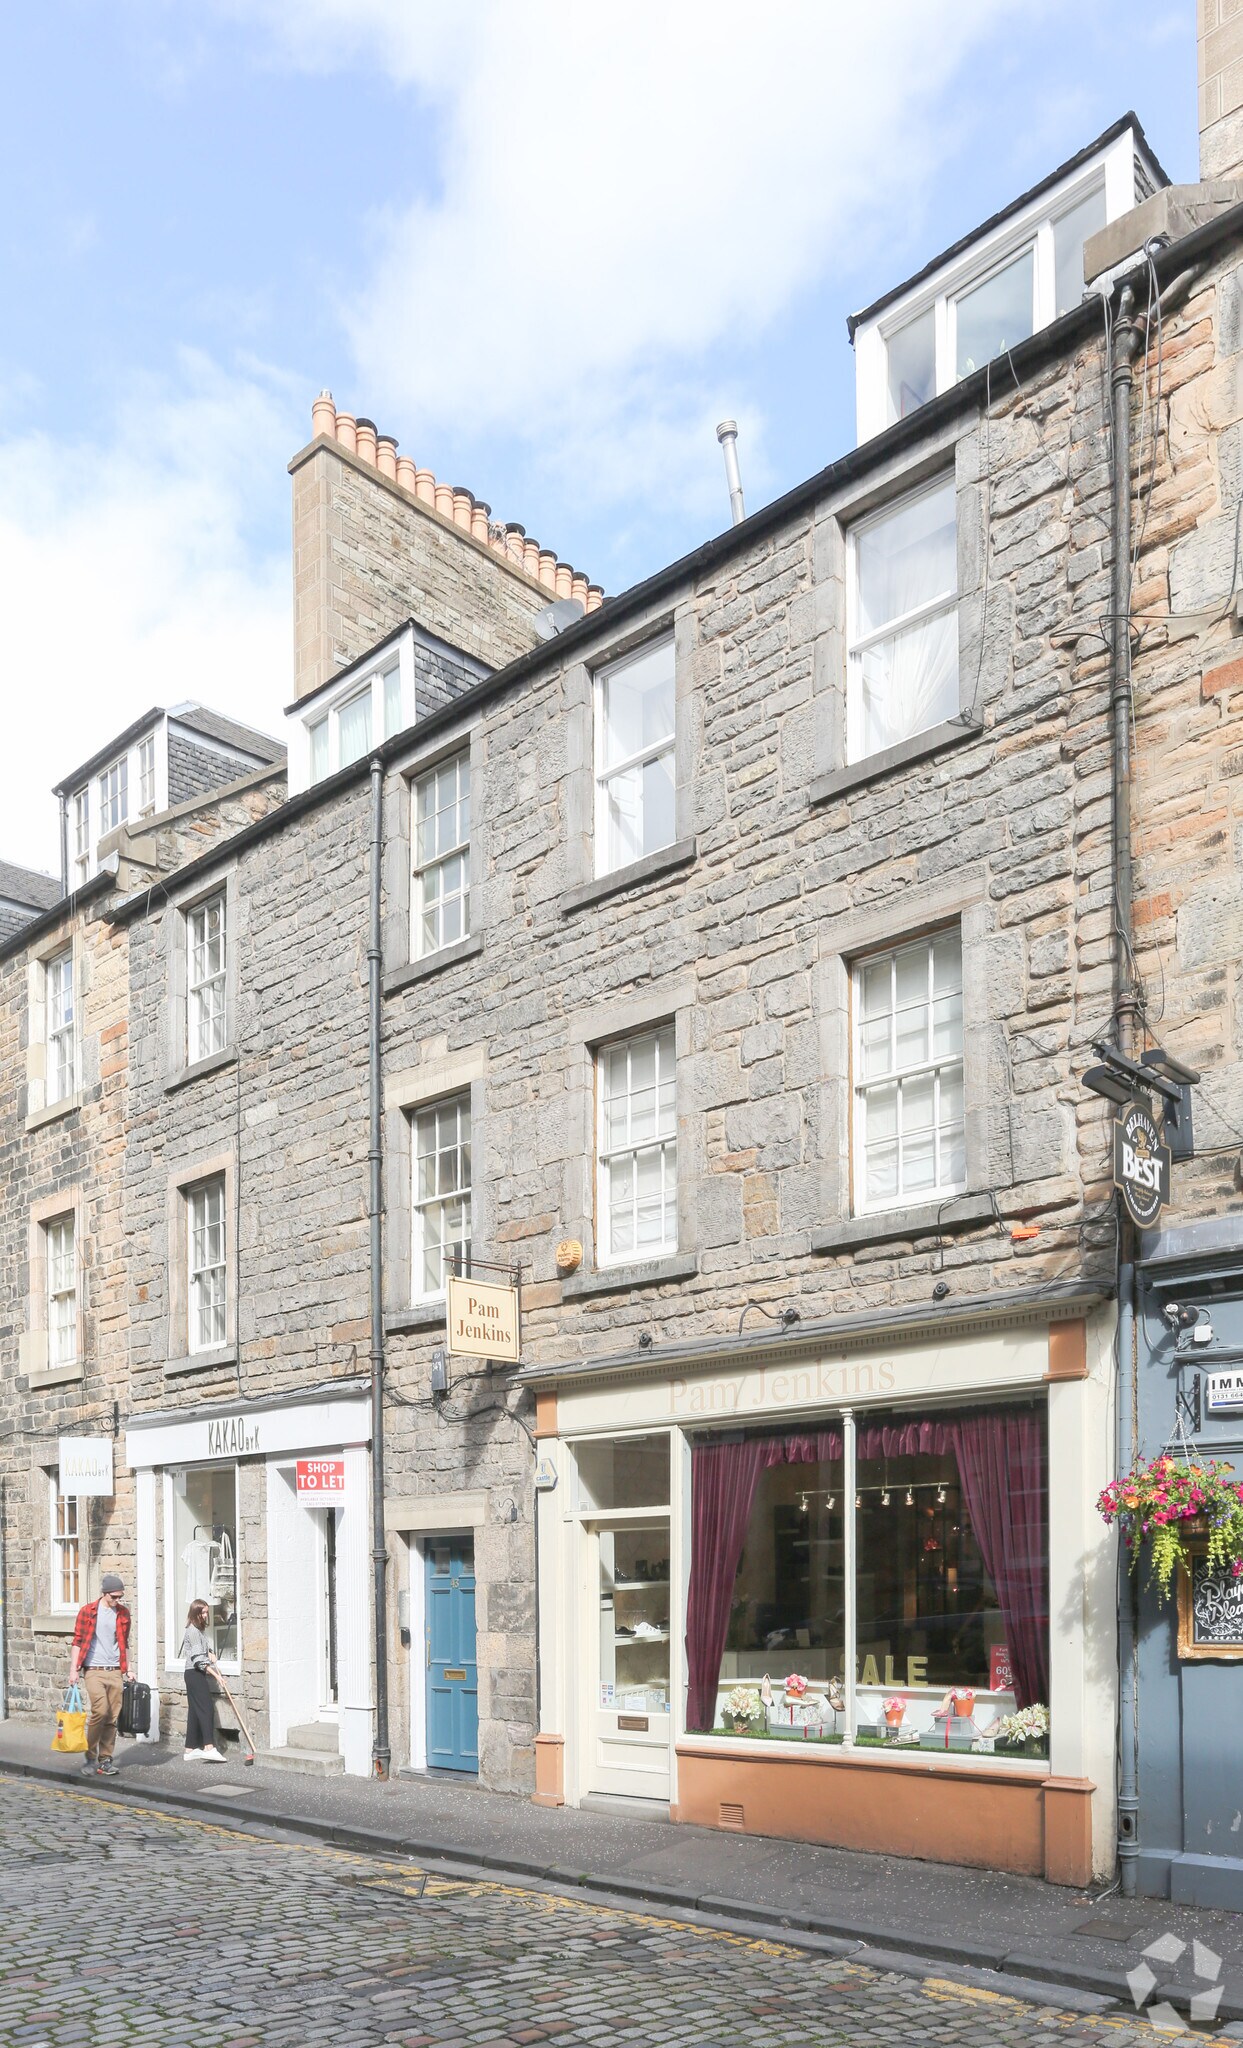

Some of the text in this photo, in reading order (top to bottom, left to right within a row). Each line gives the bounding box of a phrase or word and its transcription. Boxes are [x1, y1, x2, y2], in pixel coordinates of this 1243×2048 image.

[1125, 1113, 1160, 1152] BELHAVEN
[1122, 1141, 1163, 1193] BEST
[468, 1297, 499, 1319] Pam
[456, 1319, 512, 1344] Jenkins
[666, 1353, 896, 1414] Pam Jenkins
[307, 1462, 335, 1473] SHOP
[299, 1475, 344, 1488] TO LET
